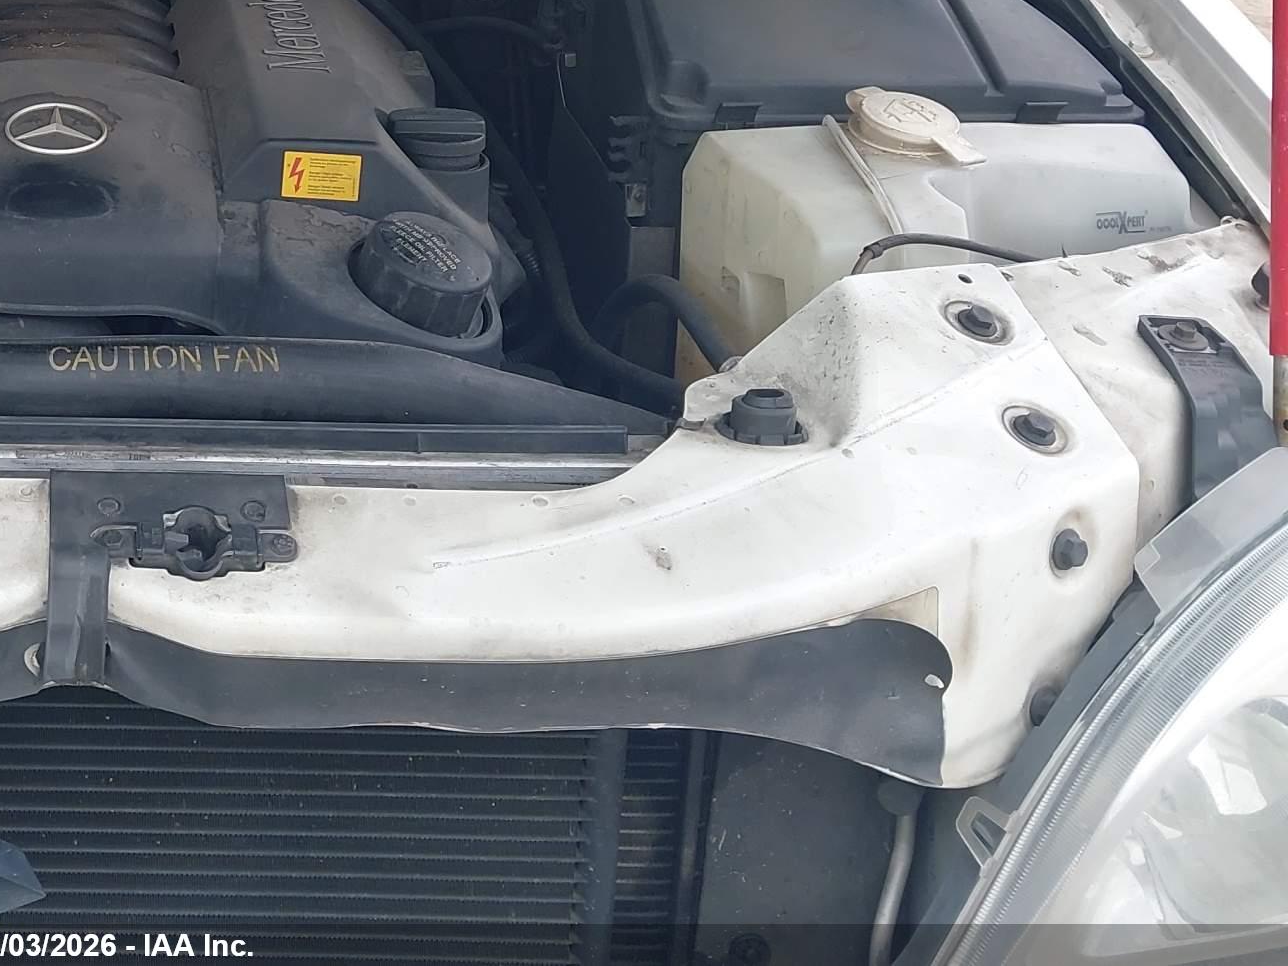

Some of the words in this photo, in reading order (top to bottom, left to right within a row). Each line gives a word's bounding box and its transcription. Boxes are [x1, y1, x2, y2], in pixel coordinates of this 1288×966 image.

[396, 237, 428, 262] ELEMENT
[414, 241, 426, 252] OIL
[426, 250, 448, 272] FILTER
[49, 345, 202, 372] CAUTION
[214, 345, 280, 372] FAN
